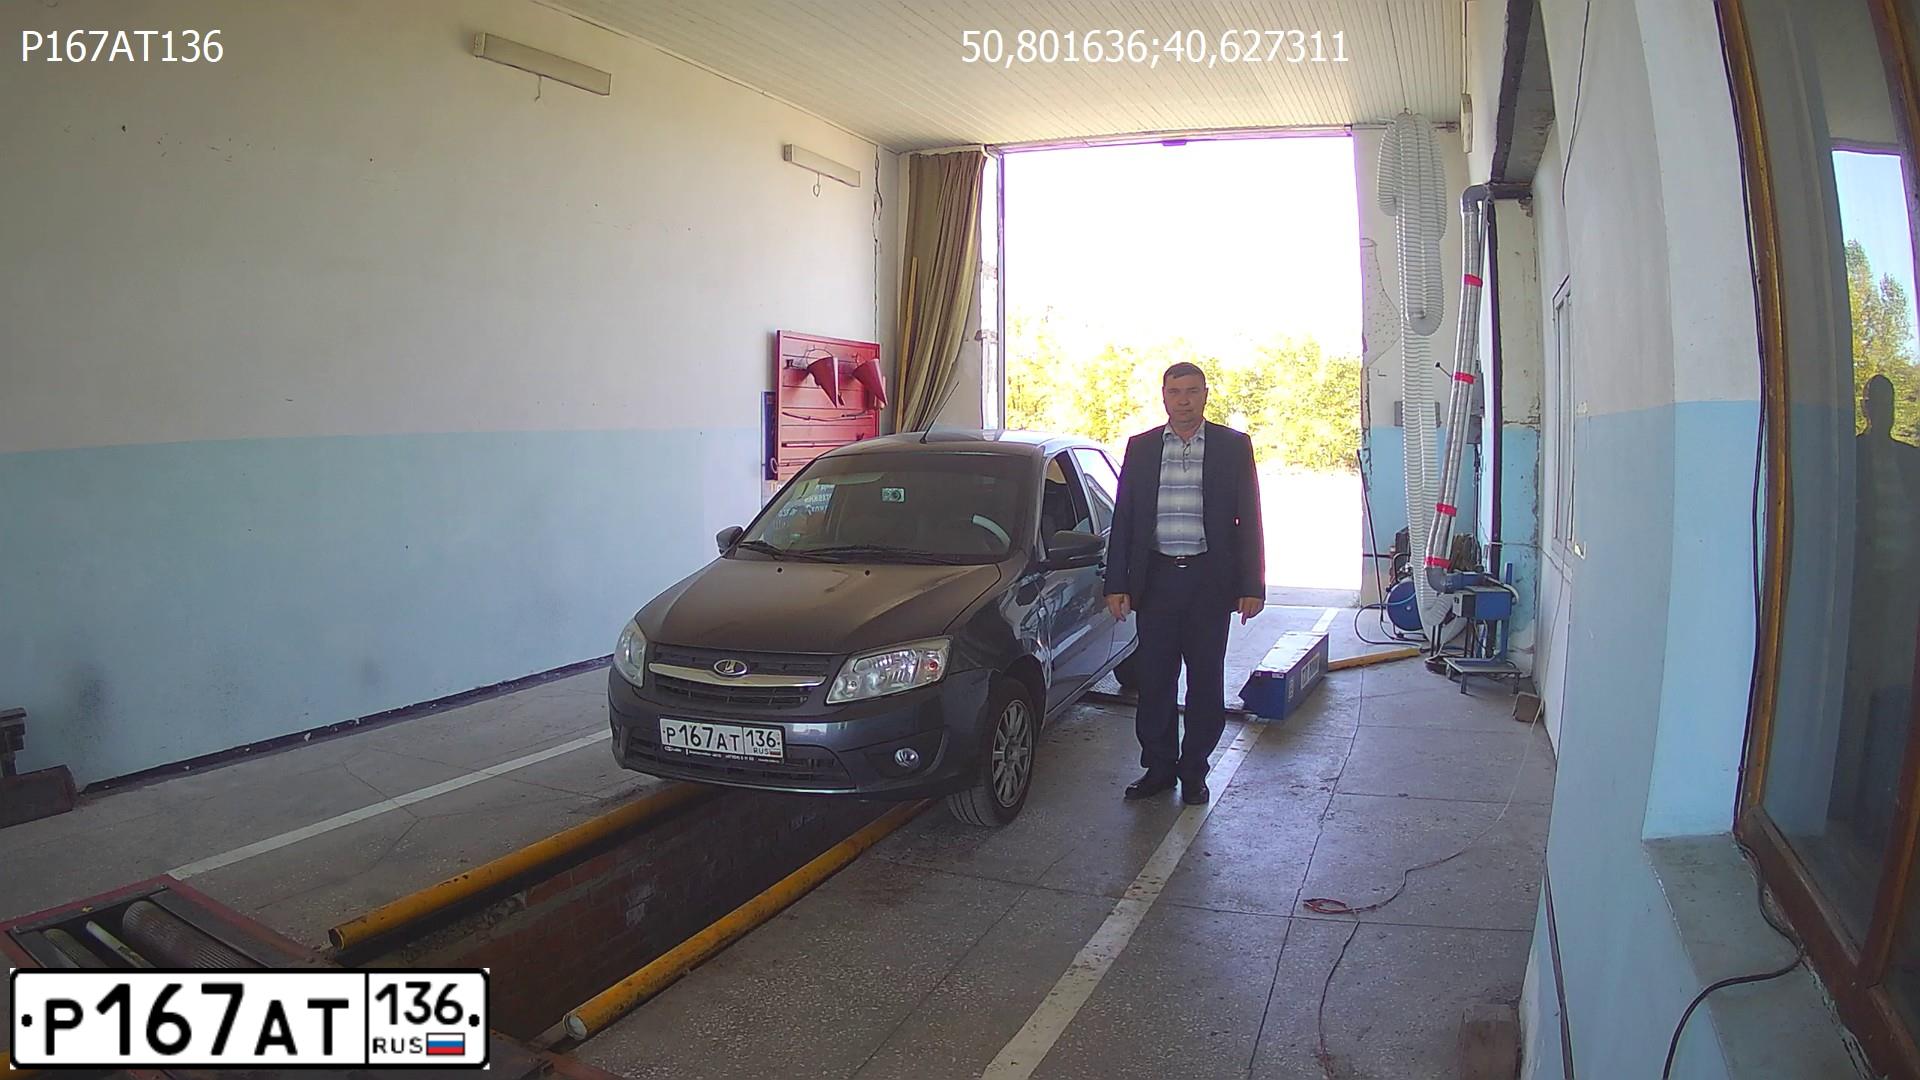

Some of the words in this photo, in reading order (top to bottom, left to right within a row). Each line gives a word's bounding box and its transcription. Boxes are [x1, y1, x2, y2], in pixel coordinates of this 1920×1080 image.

[666, 724, 740, 752] P167AT
[746, 729, 777, 748] 136
[753, 747, 769, 755] RUS
